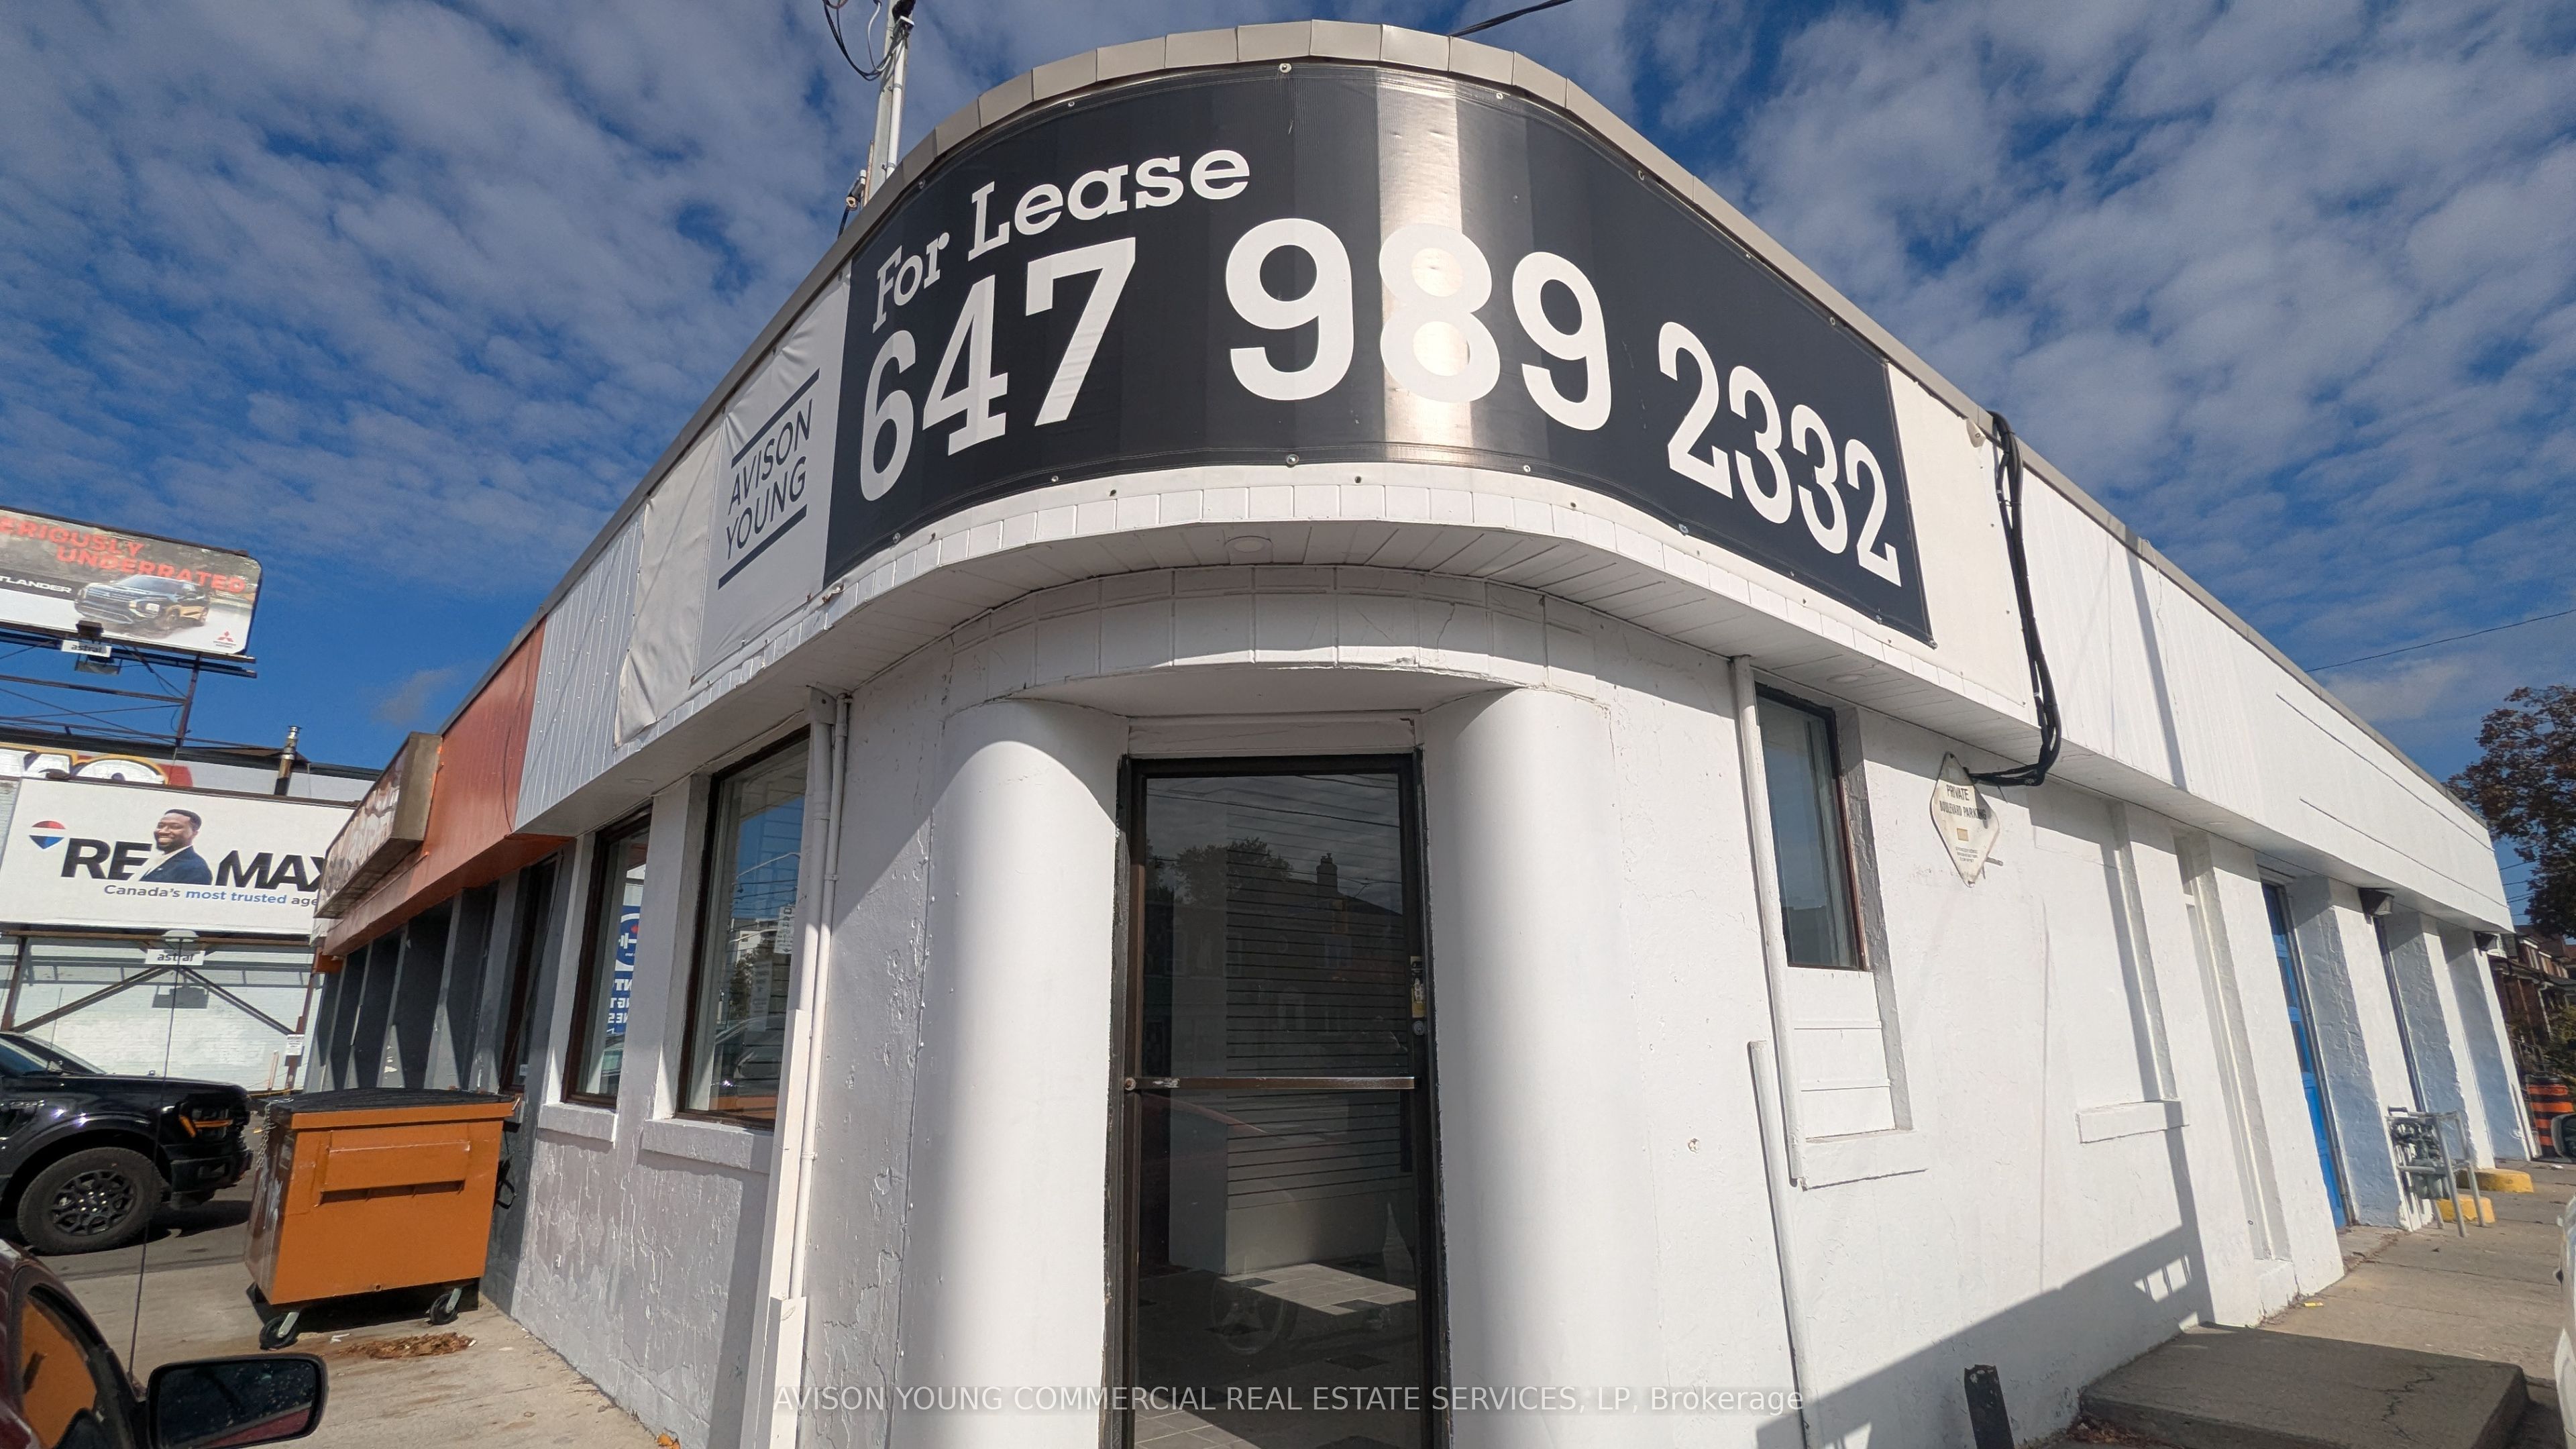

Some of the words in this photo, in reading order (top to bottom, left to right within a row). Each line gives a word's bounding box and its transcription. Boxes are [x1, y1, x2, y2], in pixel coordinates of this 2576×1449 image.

[873, 232, 949, 333] For
[968, 150, 1250, 262] Lease
[861, 237, 1136, 500] 647
[1226, 218, 1611, 430] 989
[1658, 321, 1901, 588] 2332
[728, 398, 812, 516] AVISON
[727, 456, 806, 559] YOUNG
[56, 546, 246, 593] UNDERRATED
[1946, 784, 1970, 800] PRIVATE
[1963, 806, 1986, 820] PARKING
[104, 884, 180, 898] Canada's
[185, 890, 226, 900] most
[231, 892, 287, 904] trusted
